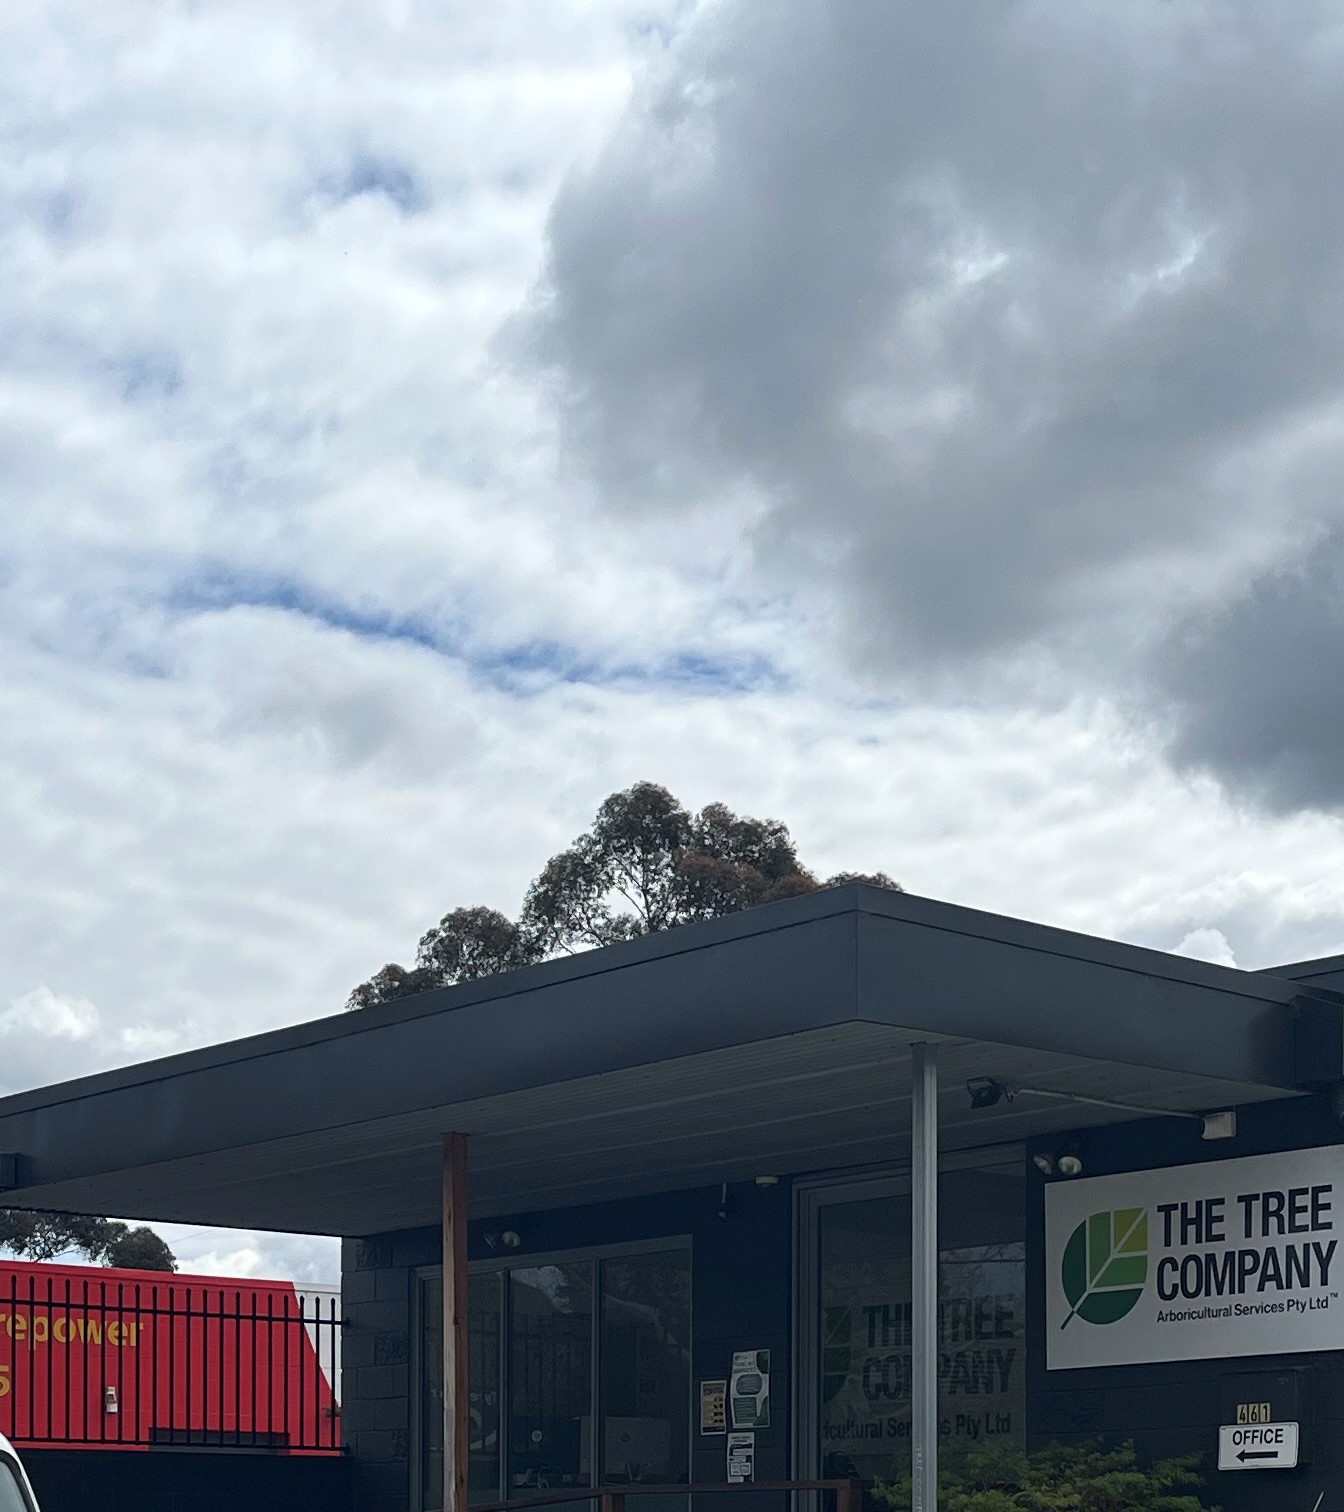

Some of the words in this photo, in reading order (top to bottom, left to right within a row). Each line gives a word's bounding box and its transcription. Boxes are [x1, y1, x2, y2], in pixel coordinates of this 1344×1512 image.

[1157, 1198, 1226, 1248] THE
[1238, 1184, 1334, 1239] TREE
[1157, 1240, 1338, 1301] COMPANY
[1156, 1304, 1233, 1324] Arboricultural
[1234, 1301, 1285, 1317] Services
[1287, 1298, 1306, 1314] Pty
[1239, 1405, 1269, 1422] 461
[1232, 1428, 1284, 1446] OFFICE
